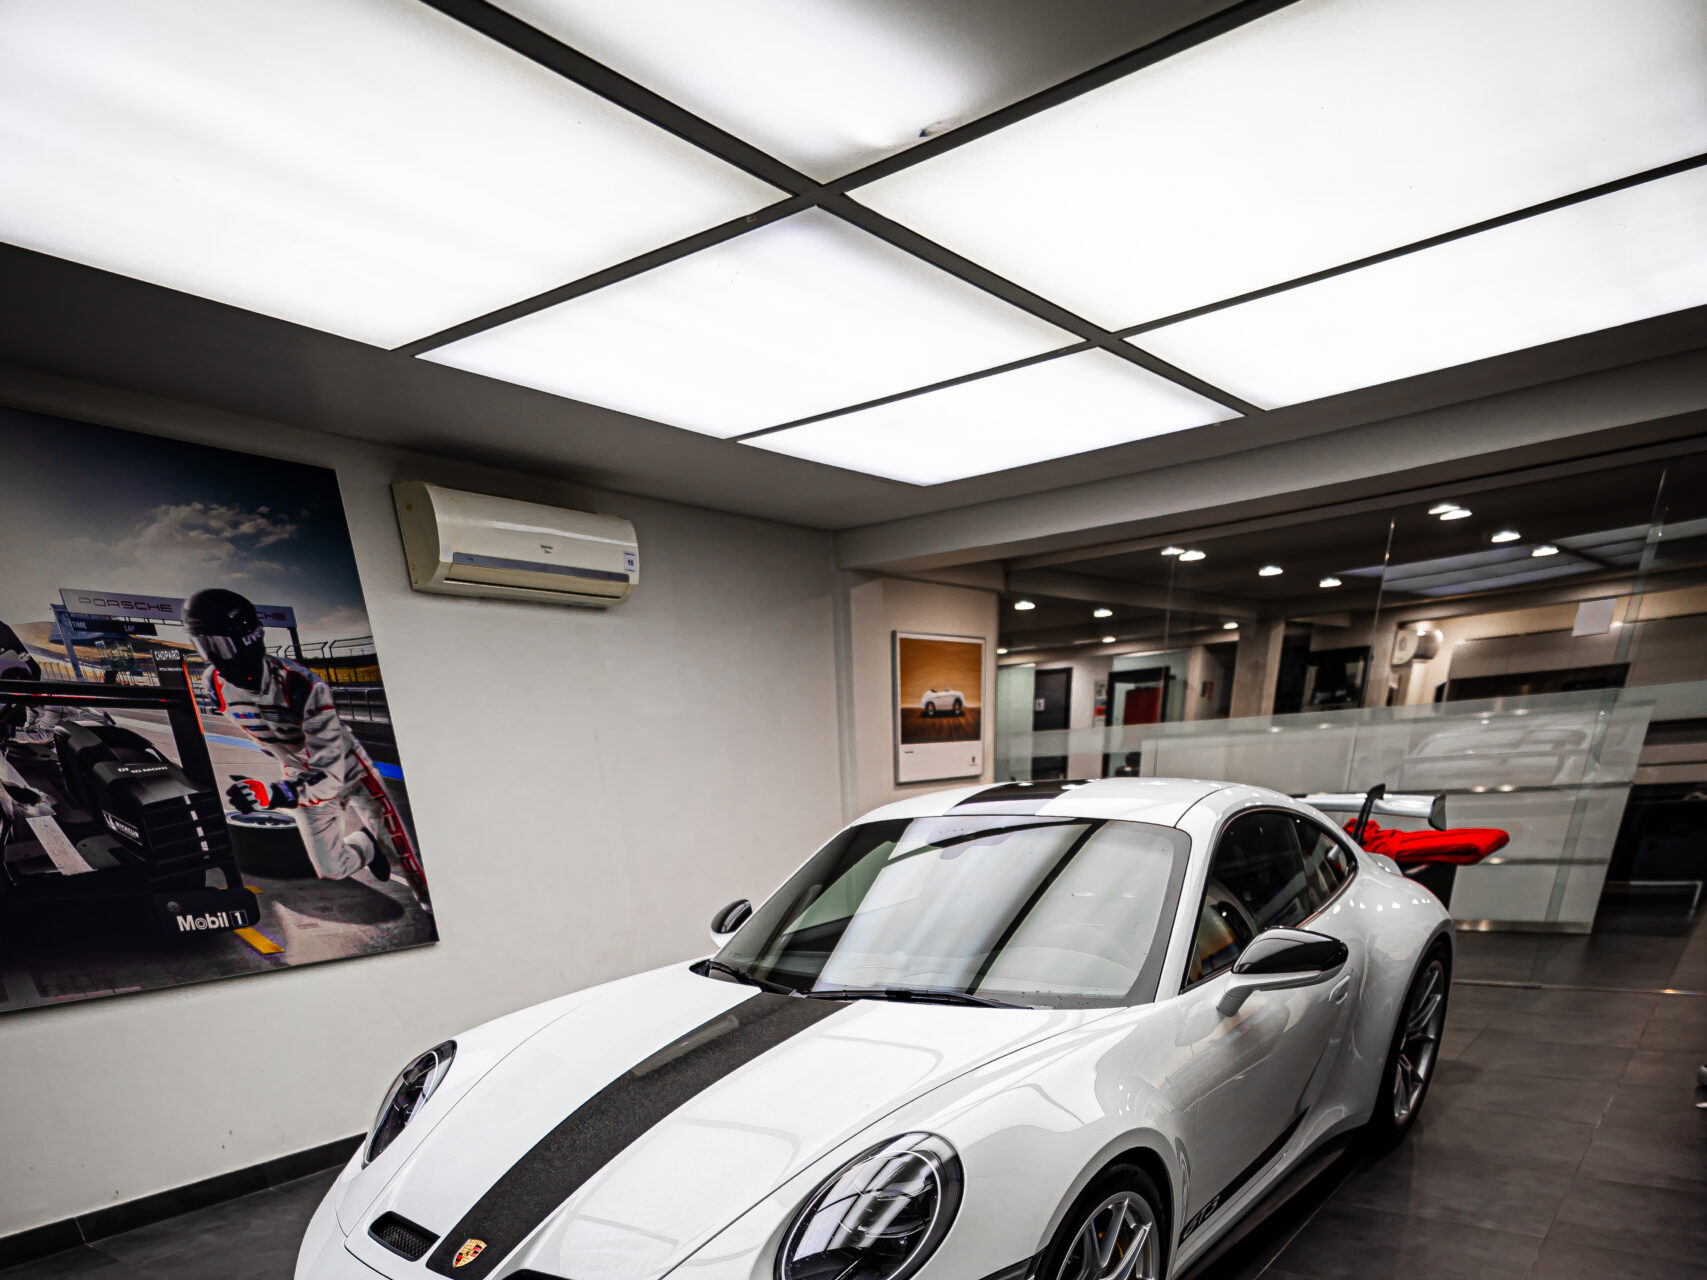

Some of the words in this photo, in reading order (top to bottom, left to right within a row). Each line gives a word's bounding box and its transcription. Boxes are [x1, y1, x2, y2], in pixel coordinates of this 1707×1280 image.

[78, 597, 174, 613] PORSCHE
[71, 621, 88, 631] TIME
[123, 624, 136, 632] LAP
[154, 649, 181, 661] CHOPARD
[176, 911, 230, 932] Mobil
[1182, 1194, 1221, 1240] GT3
